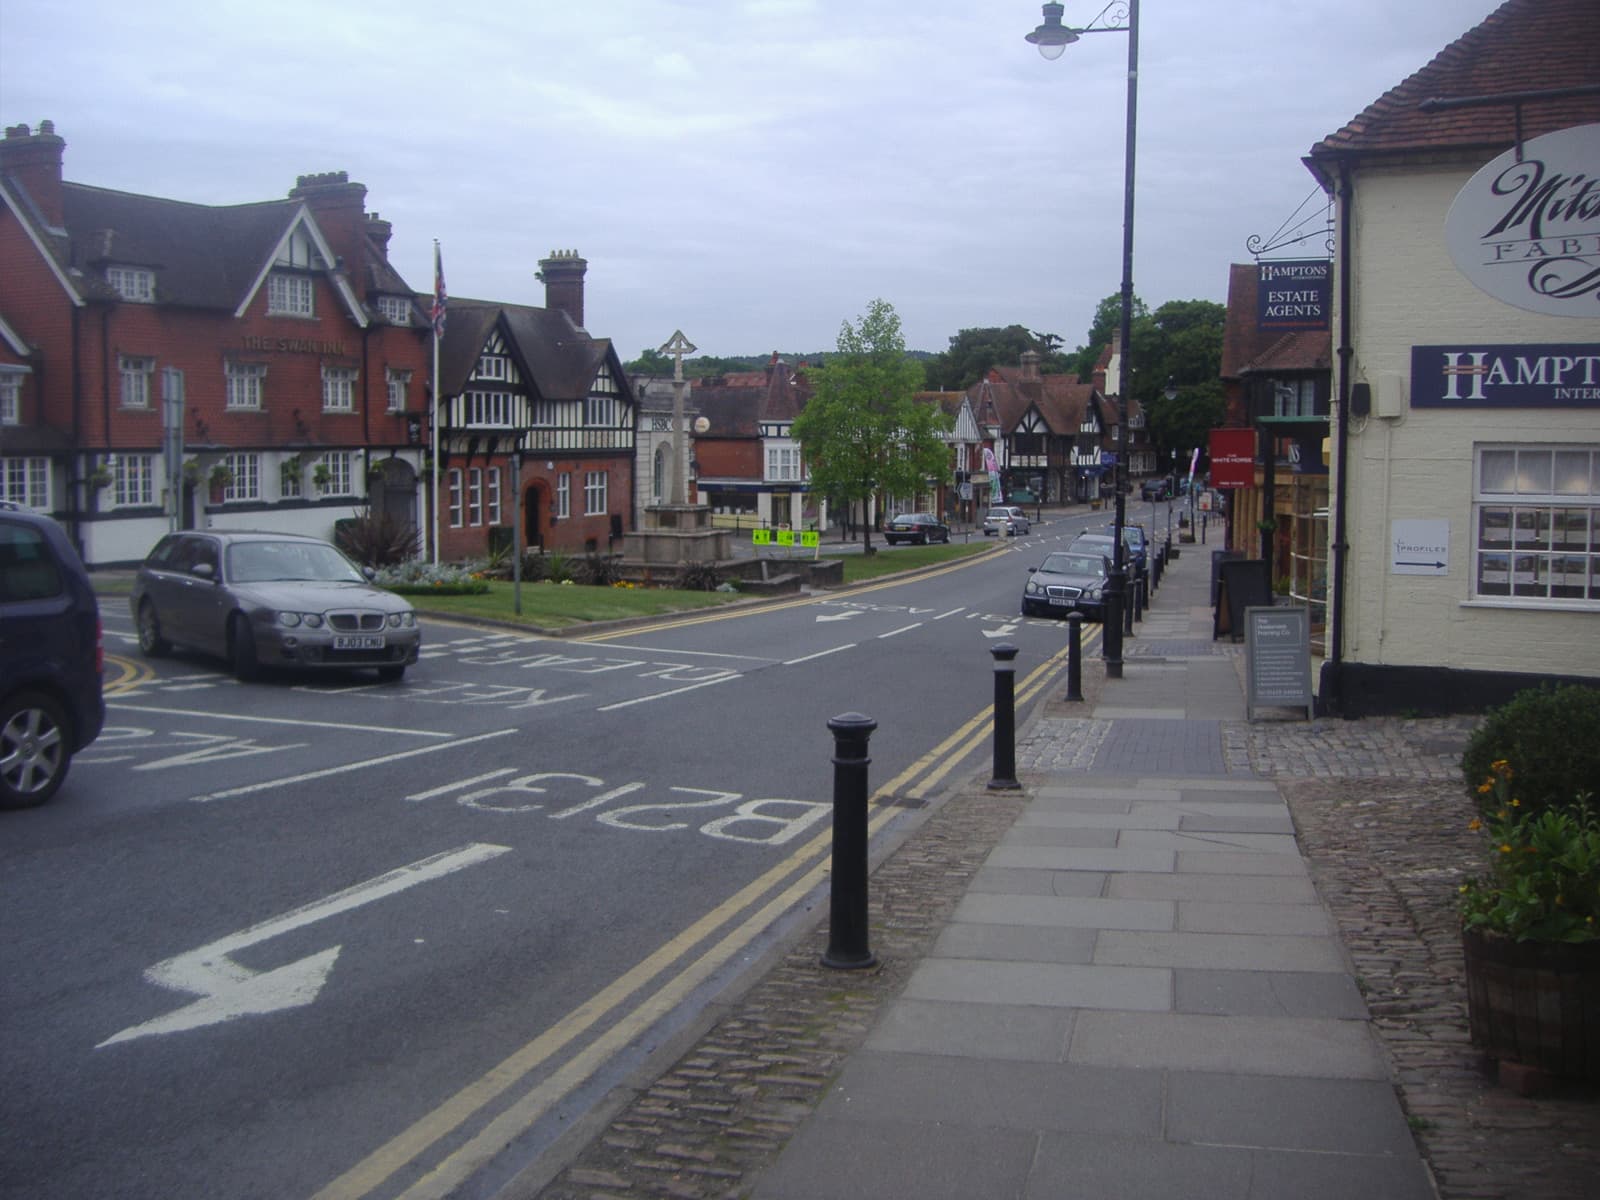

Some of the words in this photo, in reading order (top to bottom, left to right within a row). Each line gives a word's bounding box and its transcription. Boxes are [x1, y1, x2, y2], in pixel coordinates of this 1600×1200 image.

[1261, 266, 1327, 280] HAMPTONS
[1268, 290, 1319, 302] ESTATE
[1265, 304, 1321, 317] AGENTS
[241, 335, 271, 350] THE
[277, 336, 318, 353] SWAN
[322, 338, 346, 354] INN
[1442, 352, 1600, 399] HAMPT
[1554, 387, 1600, 400] INTER
[457, 650, 738, 681] CLEAR
[405, 767, 834, 845] B2131
